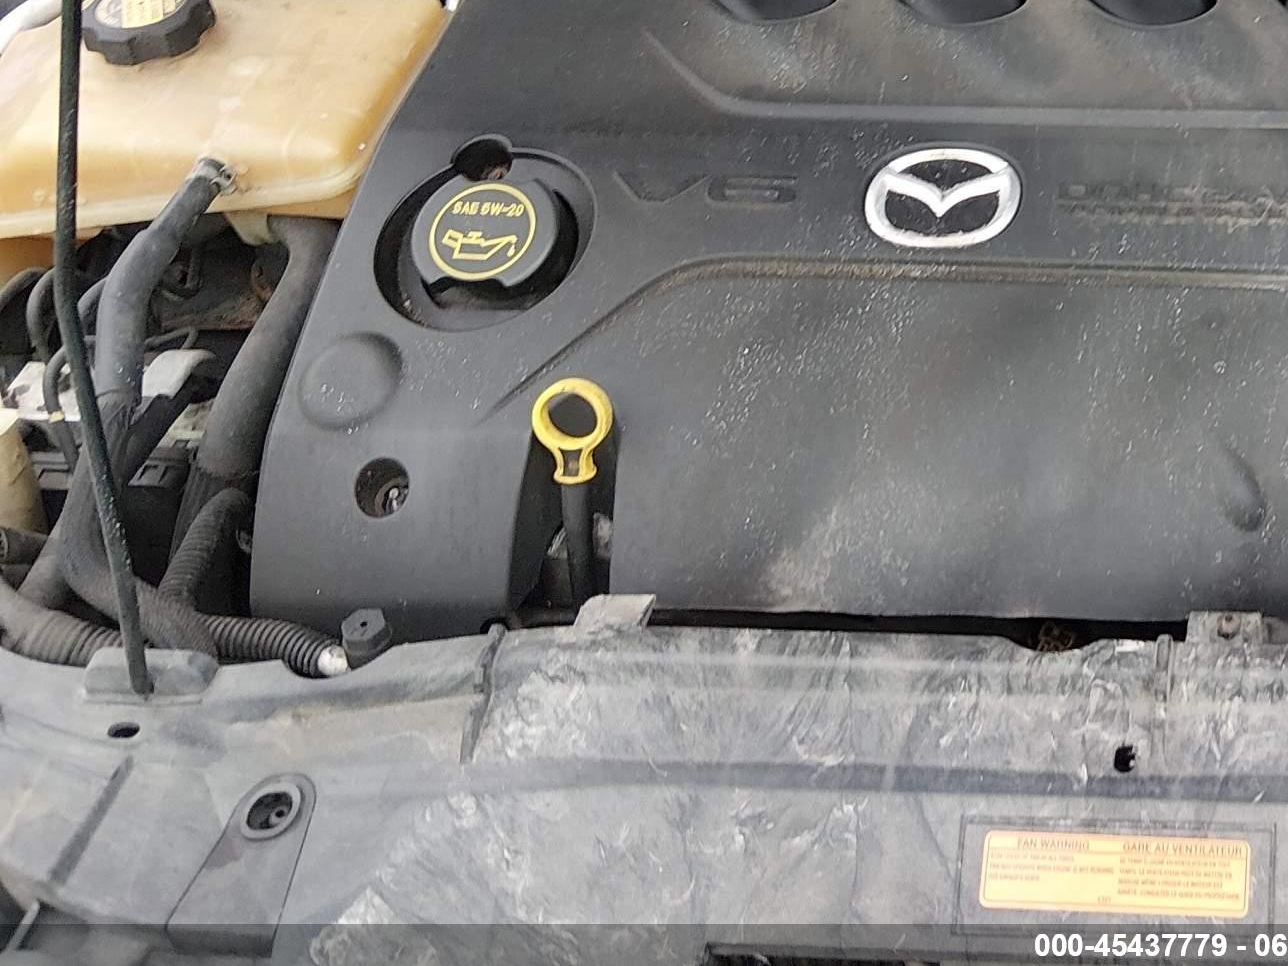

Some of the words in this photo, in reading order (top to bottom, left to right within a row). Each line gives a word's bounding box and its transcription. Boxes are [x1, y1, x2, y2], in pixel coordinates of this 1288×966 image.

[452, 201, 478, 215] SAE
[1017, 838, 1037, 851] FAN
[1040, 838, 1090, 852] WARNING
